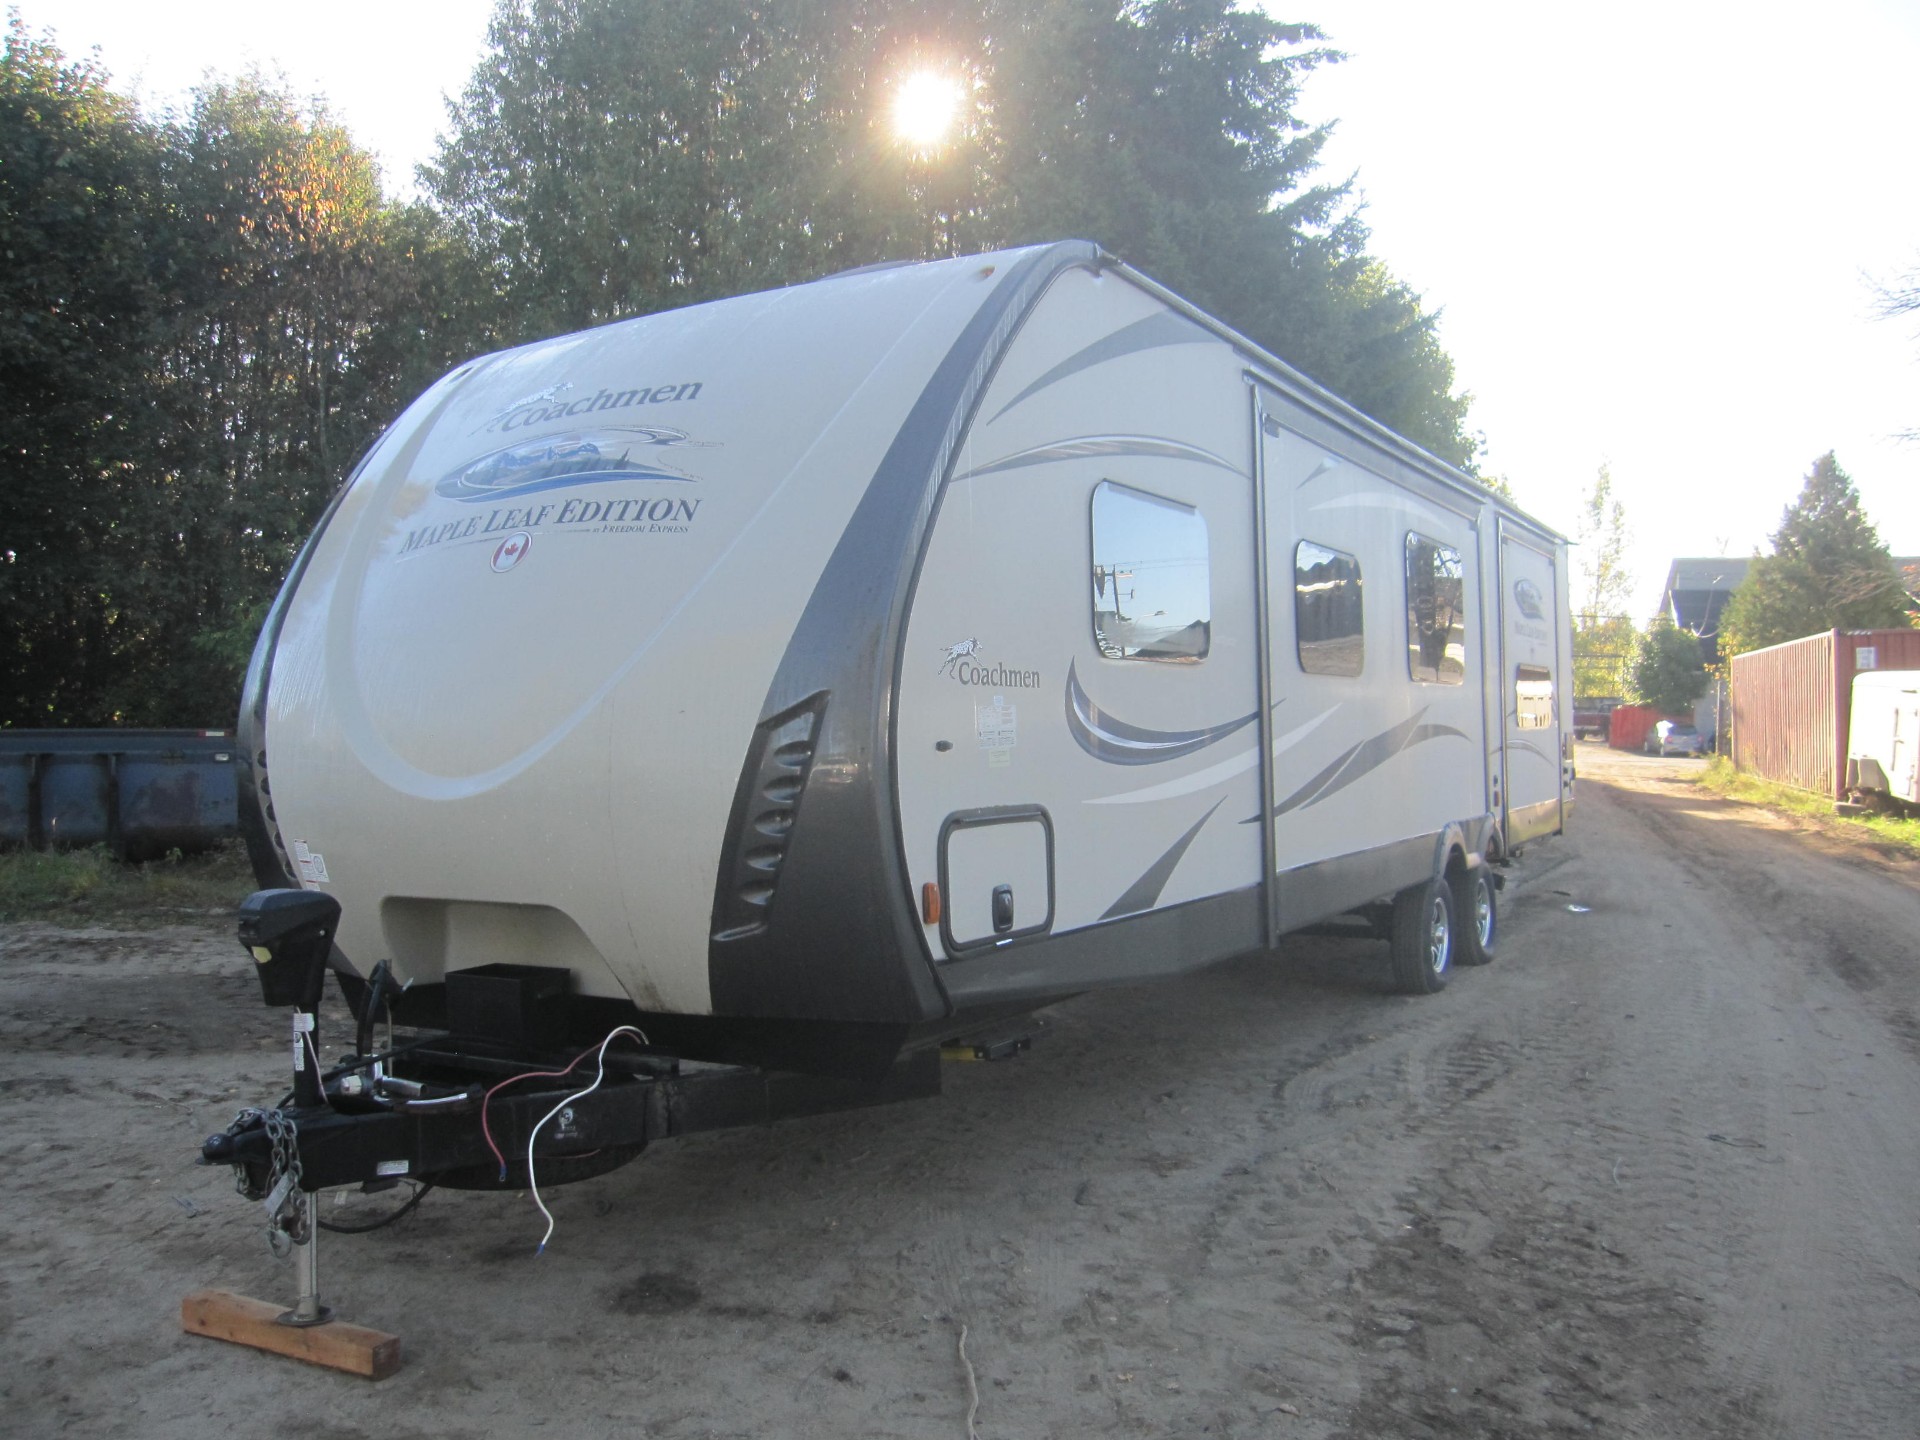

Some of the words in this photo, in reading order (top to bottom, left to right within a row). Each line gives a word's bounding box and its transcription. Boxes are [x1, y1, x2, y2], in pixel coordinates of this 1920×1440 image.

[501, 381, 704, 432] Coachmen
[398, 516, 483, 555] MAPLE
[481, 504, 556, 533] LEAF
[553, 497, 703, 524] EDITION
[602, 523, 646, 533] FREEDOM
[649, 523, 690, 533] EXPRESS
[958, 661, 1041, 689] Coachmen
